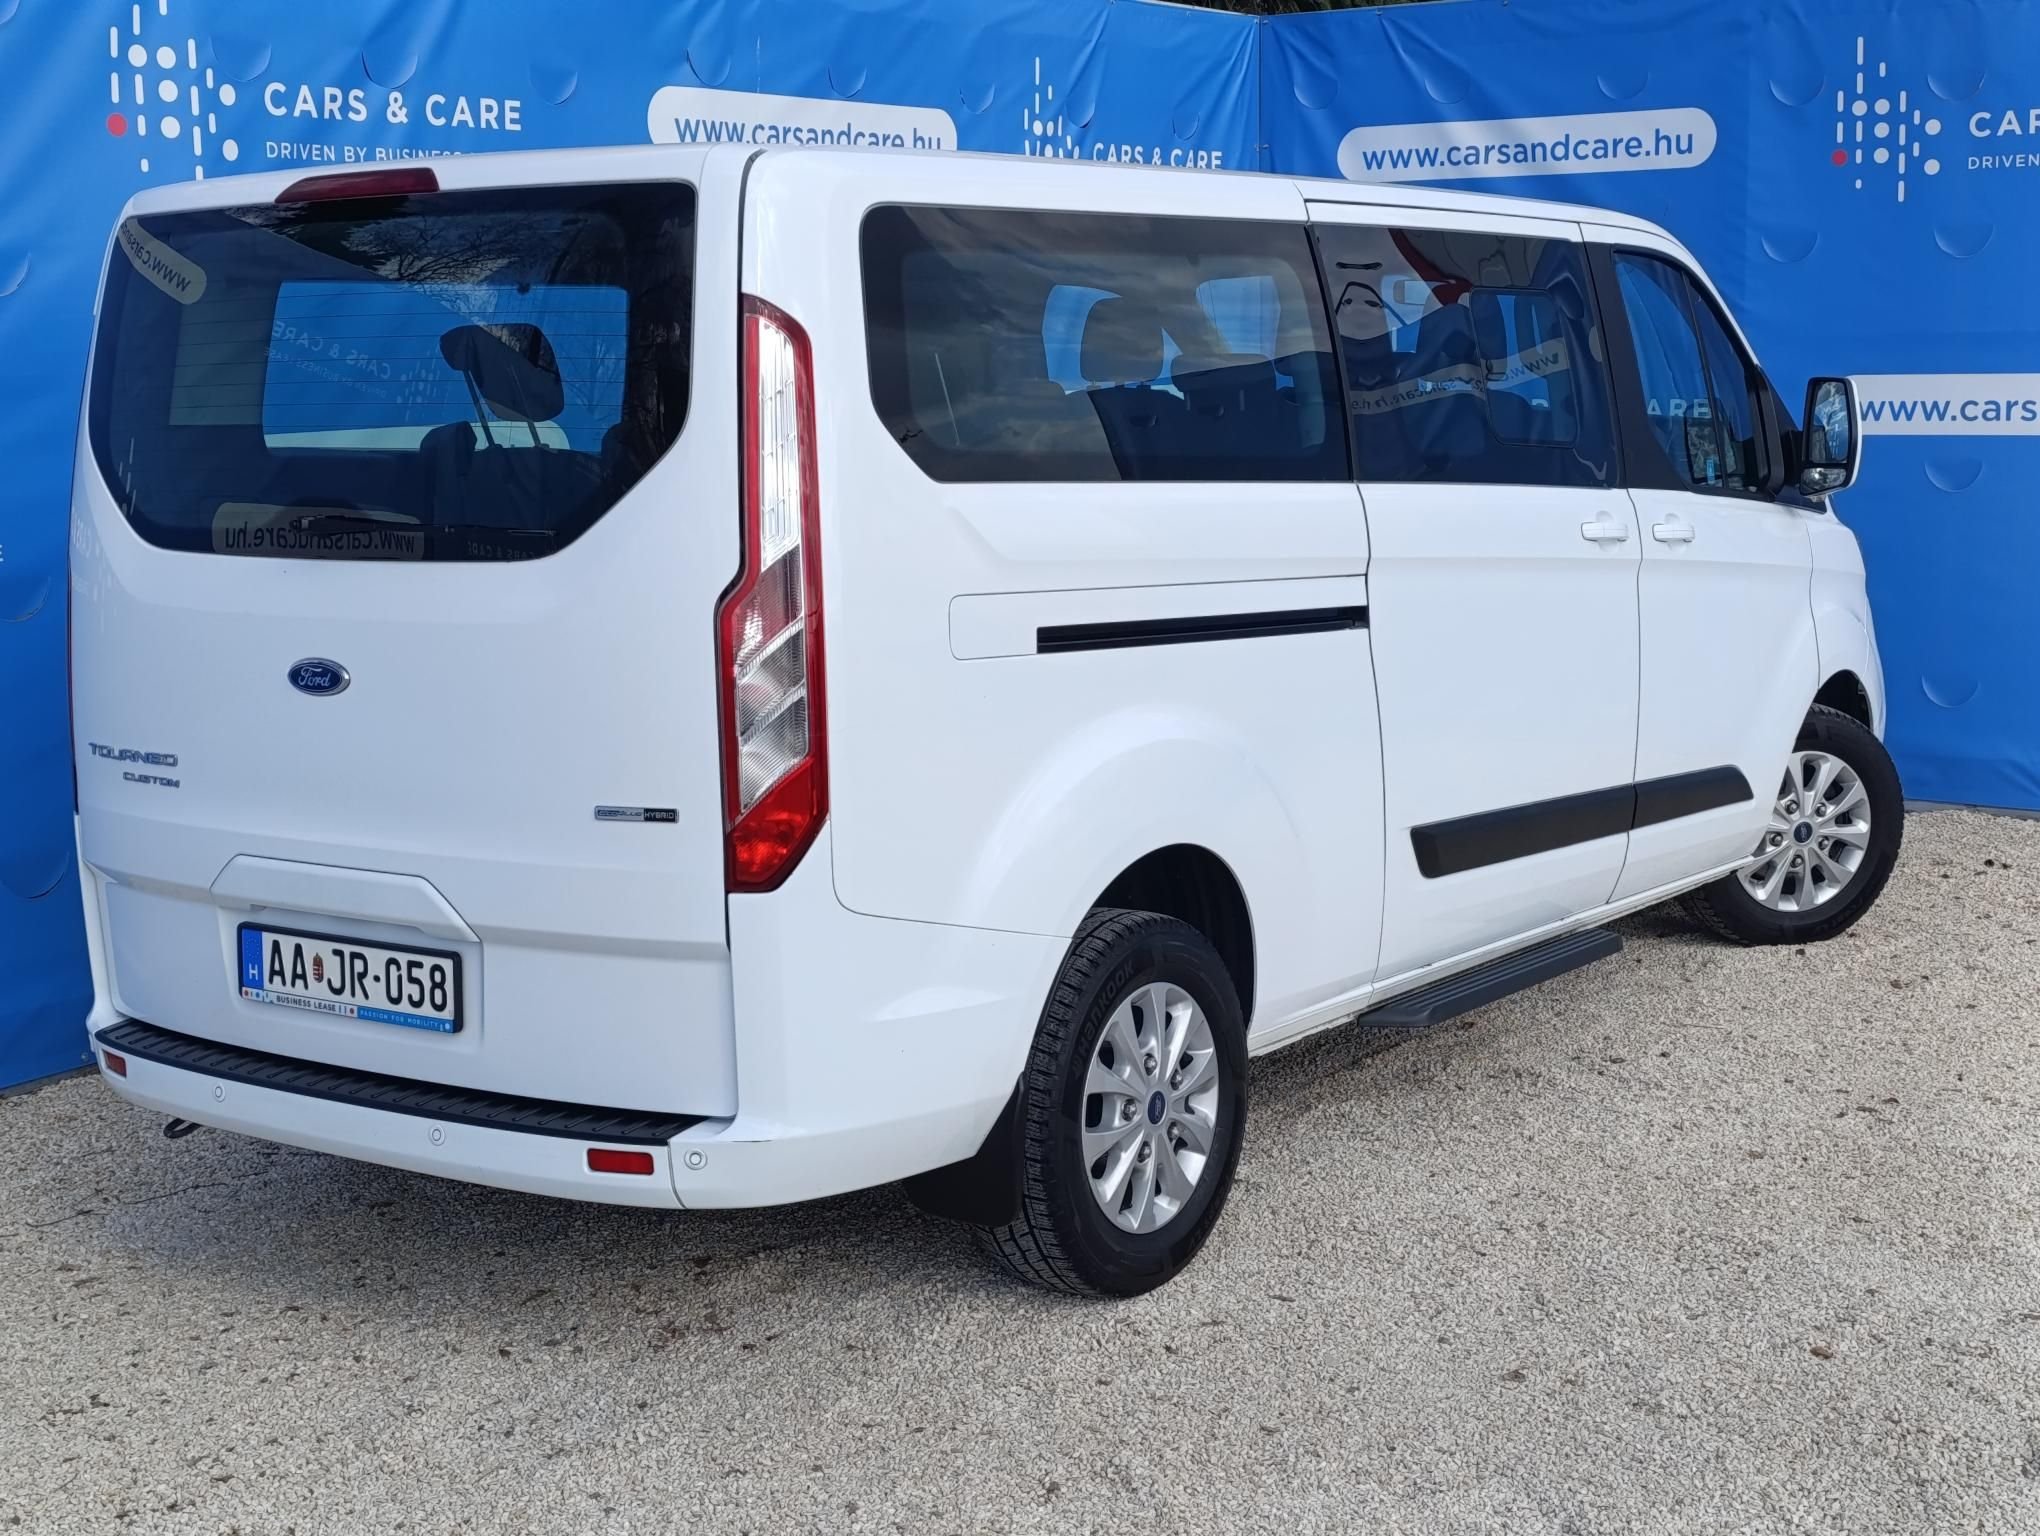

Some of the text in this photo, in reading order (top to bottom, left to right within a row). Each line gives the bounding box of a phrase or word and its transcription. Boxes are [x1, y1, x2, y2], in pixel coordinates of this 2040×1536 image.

[264, 82, 522, 131] CARS & CARE
[674, 117, 941, 150] www.carsandcarehu
[266, 141, 336, 162] DRIVEN
[344, 146, 367, 163] BY
[1093, 142, 1144, 165] CARS
[1170, 149, 1223, 170] CARE
[1362, 128, 1694, 170] www.carsandcare.hu
[1968, 153, 2040, 169] DRIVEN
[1647, 398, 1713, 418] ARE
[298, 666, 331, 687] Ford
[88, 742, 178, 767] TOURNEO
[123, 772, 180, 788] CUSTOM
[644, 811, 675, 819] HYBRID
[248, 963, 259, 981] H
[268, 939, 309, 990] AA
[276, 994, 337, 1012] BUSINESS LEASE
[360, 1009, 388, 1019] PASSION
[407, 1018, 439, 1029] MOBILITY
